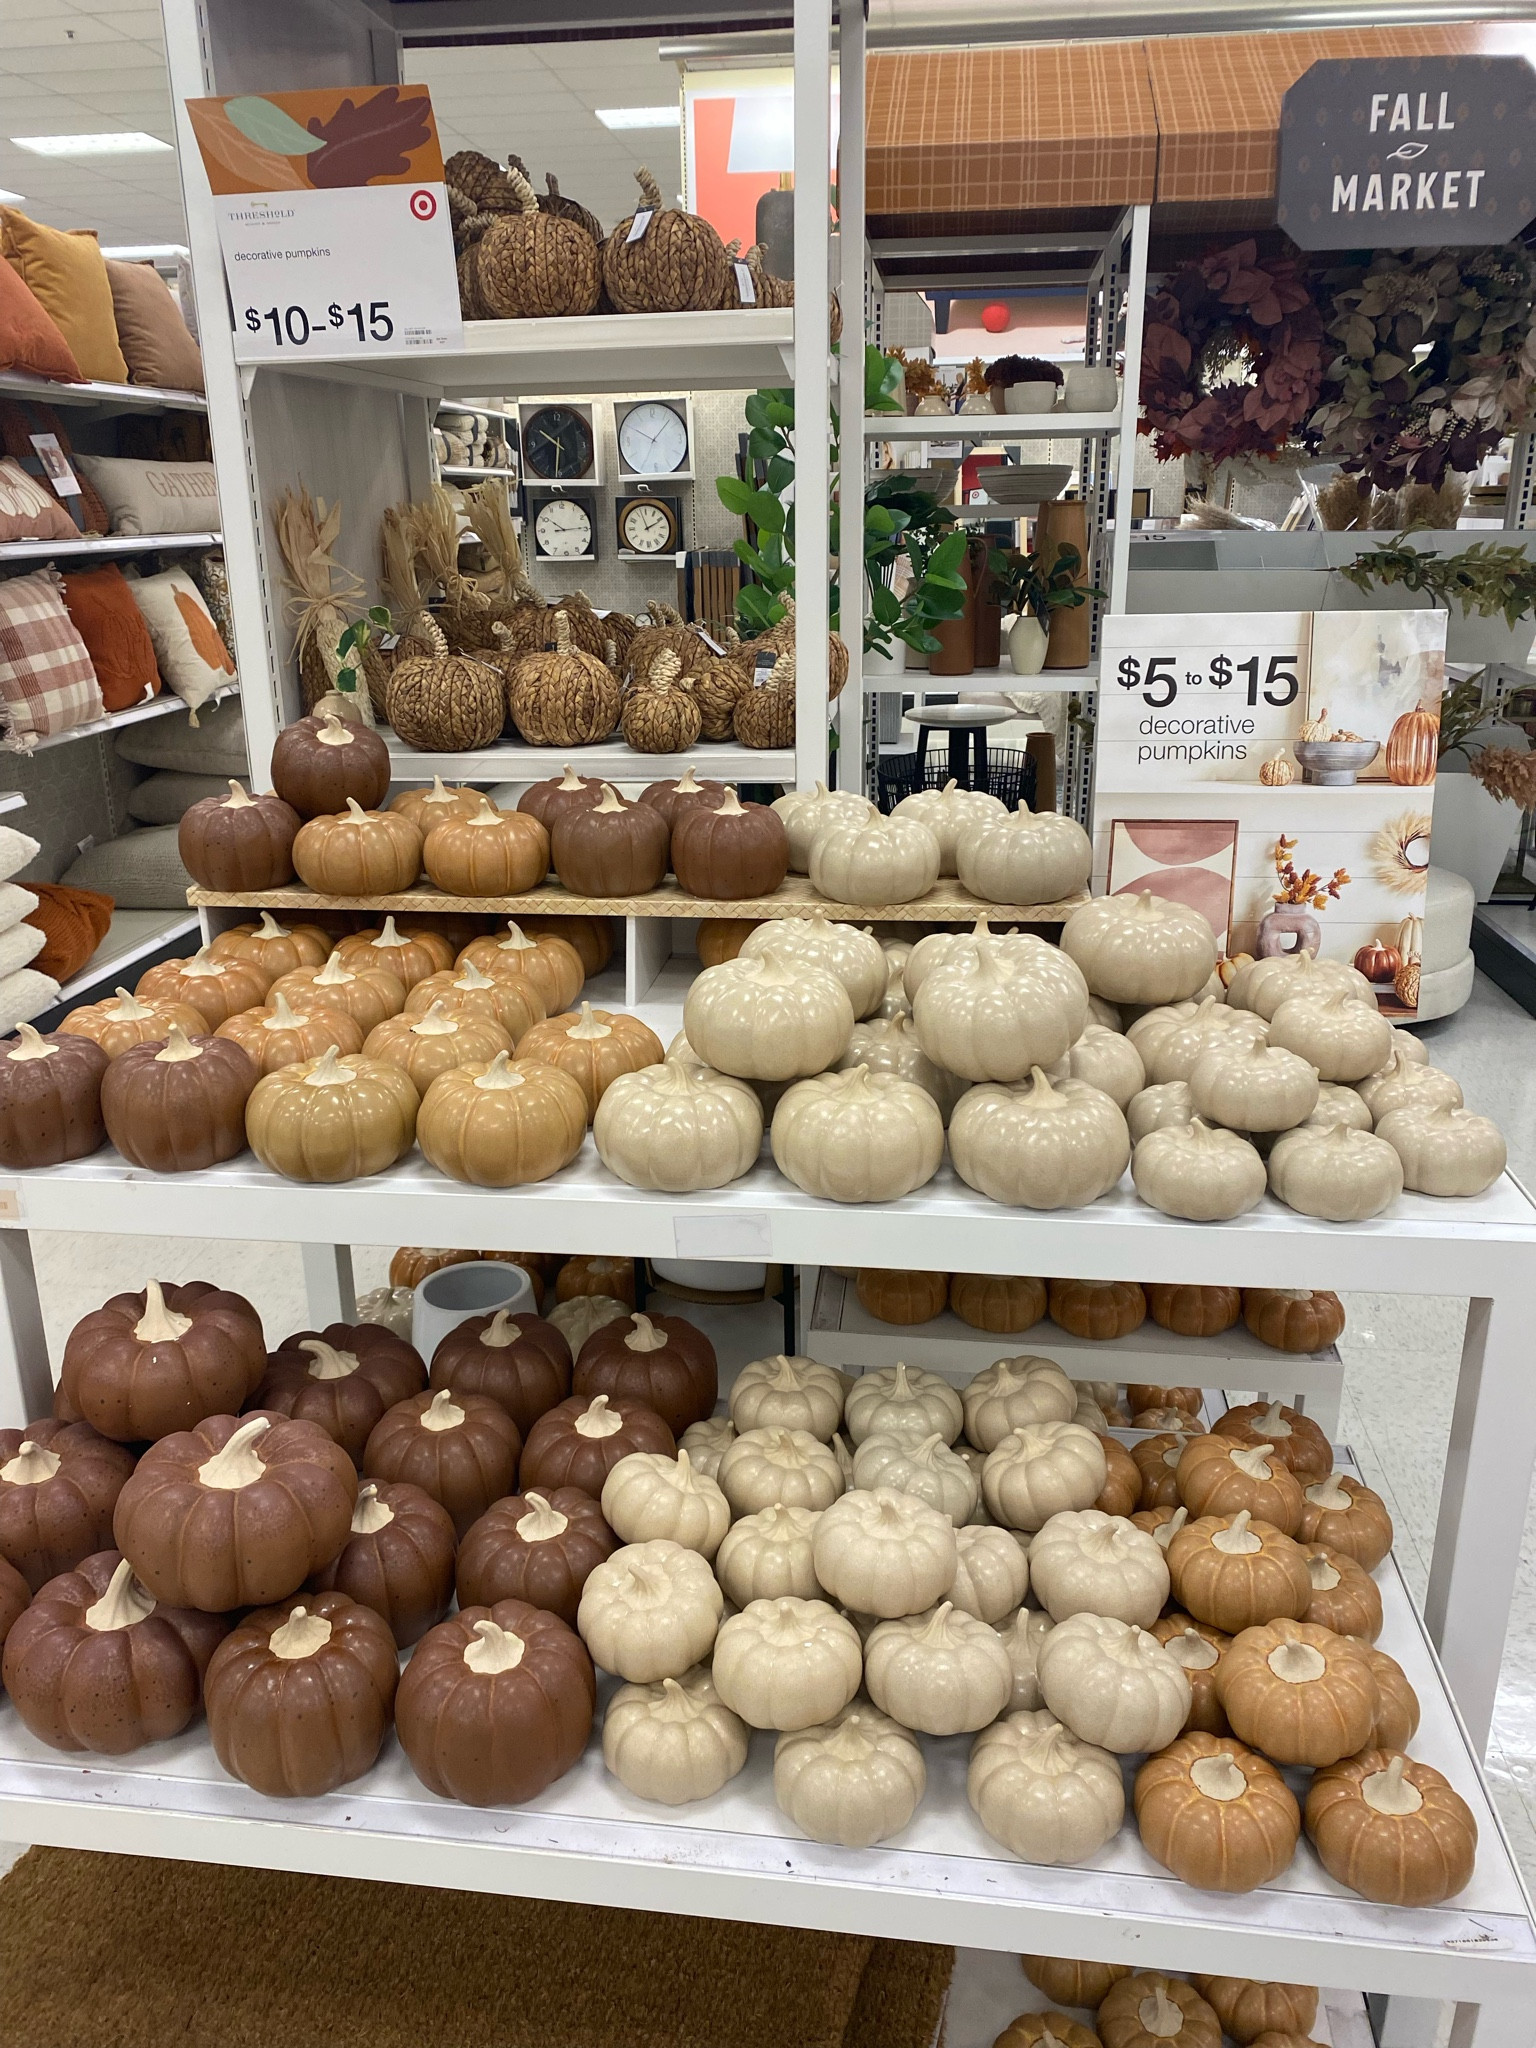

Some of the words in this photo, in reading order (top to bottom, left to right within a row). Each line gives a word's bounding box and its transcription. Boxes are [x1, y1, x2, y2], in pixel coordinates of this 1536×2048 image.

[1369, 91, 1455, 133] FALL
[1331, 169, 1486, 213] MARKET
[228, 209, 295, 221] THRESHOLD
[234, 249, 283, 262] decorative
[285, 247, 331, 260] pumpkins
[1116, 655, 1178, 708] $5
[1185, 671, 1203, 685] to
[1208, 653, 1299, 707] $15
[1139, 714, 1255, 735] decorative
[1138, 740, 1247, 764] pumpkins
